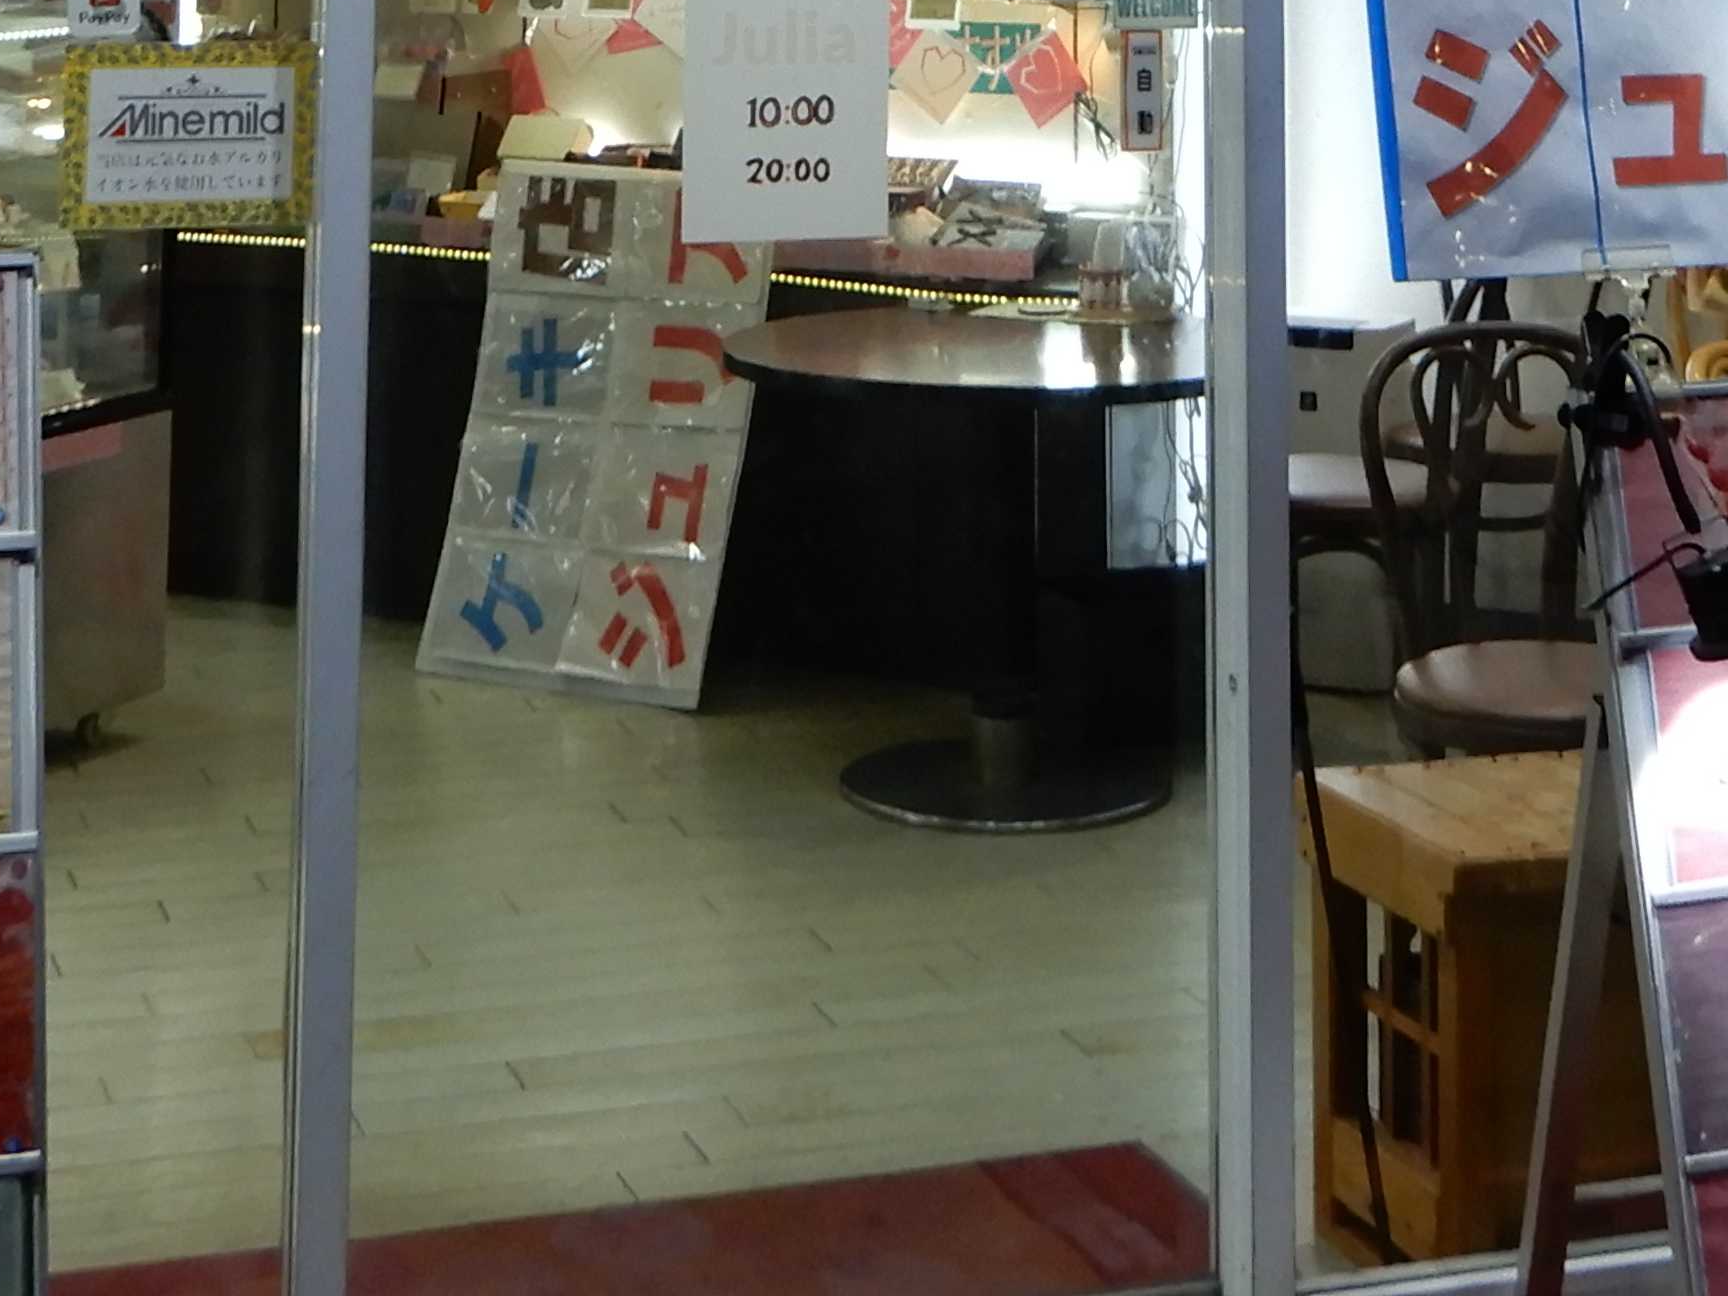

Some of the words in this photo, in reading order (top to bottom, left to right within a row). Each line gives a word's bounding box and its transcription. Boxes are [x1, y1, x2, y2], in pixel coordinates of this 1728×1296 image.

[98, 101, 285, 138] Minemild
[746, 94, 835, 128] 10:00
[746, 158, 832, 184] 20:00
